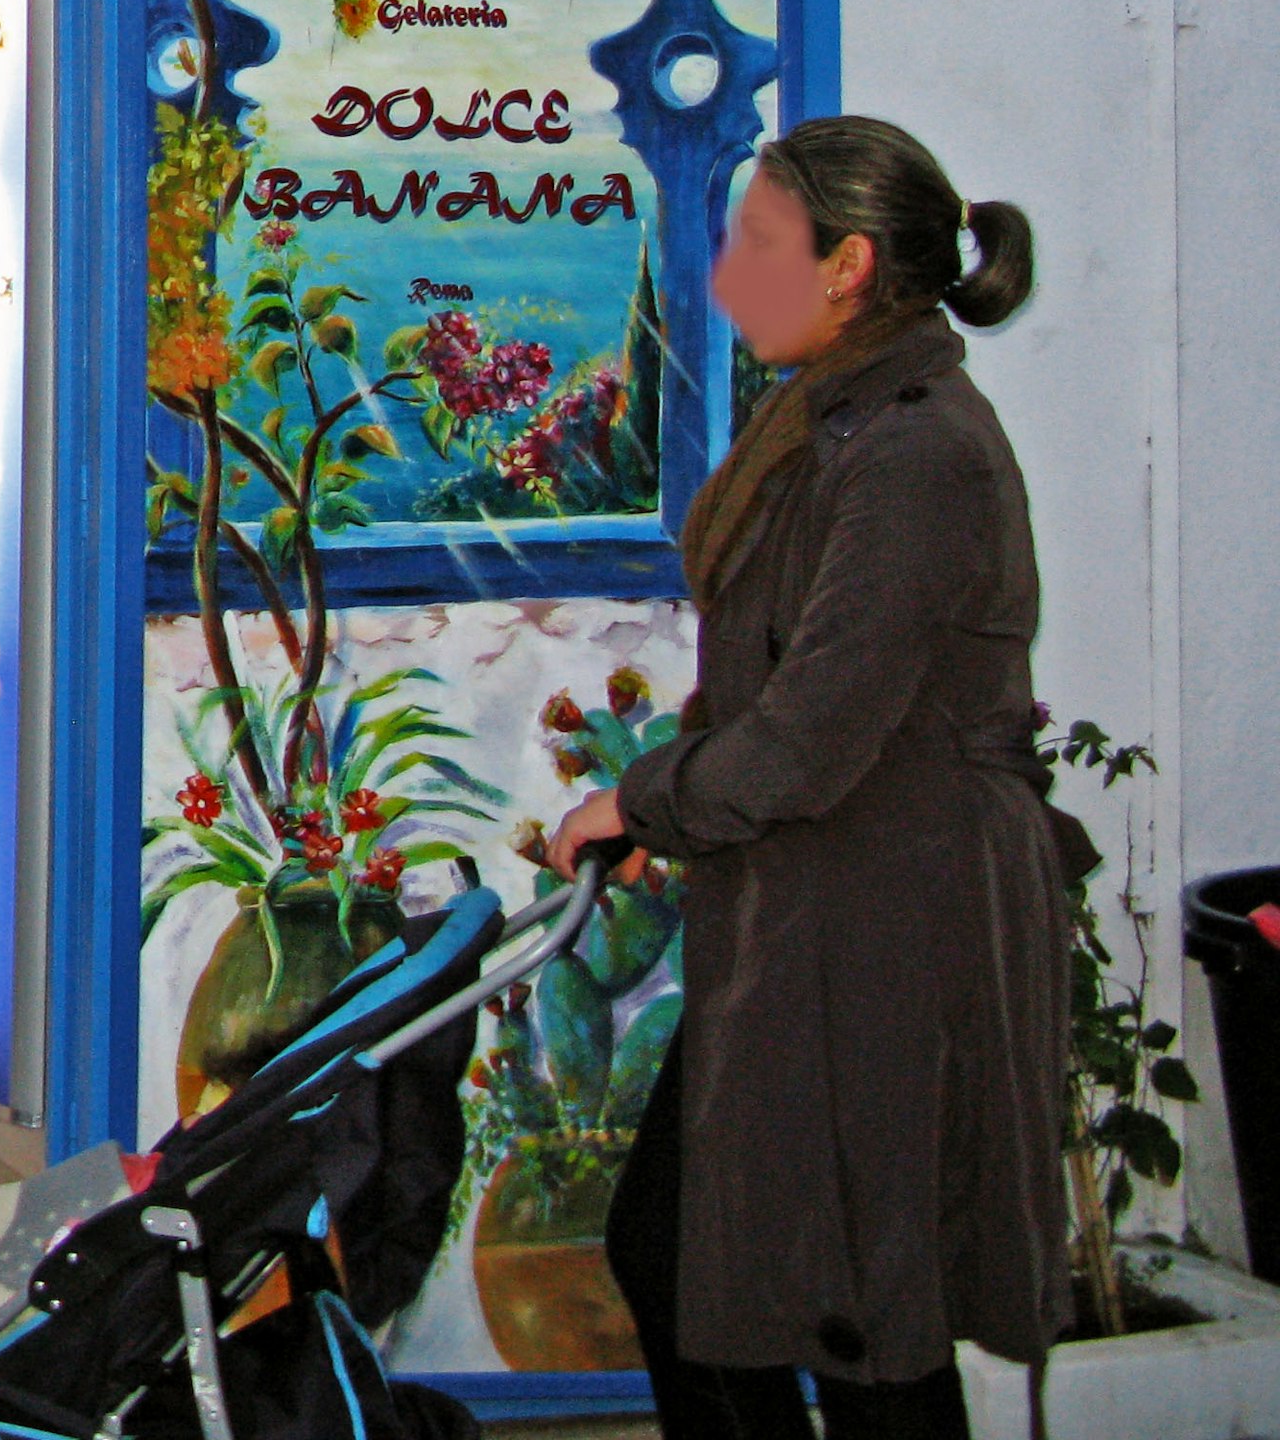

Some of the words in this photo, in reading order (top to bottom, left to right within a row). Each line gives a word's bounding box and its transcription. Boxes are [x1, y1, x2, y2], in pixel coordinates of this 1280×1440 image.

[311, 84, 573, 145] DOLCE
[242, 167, 637, 226] BANANA
[407, 276, 474, 305] Roma
